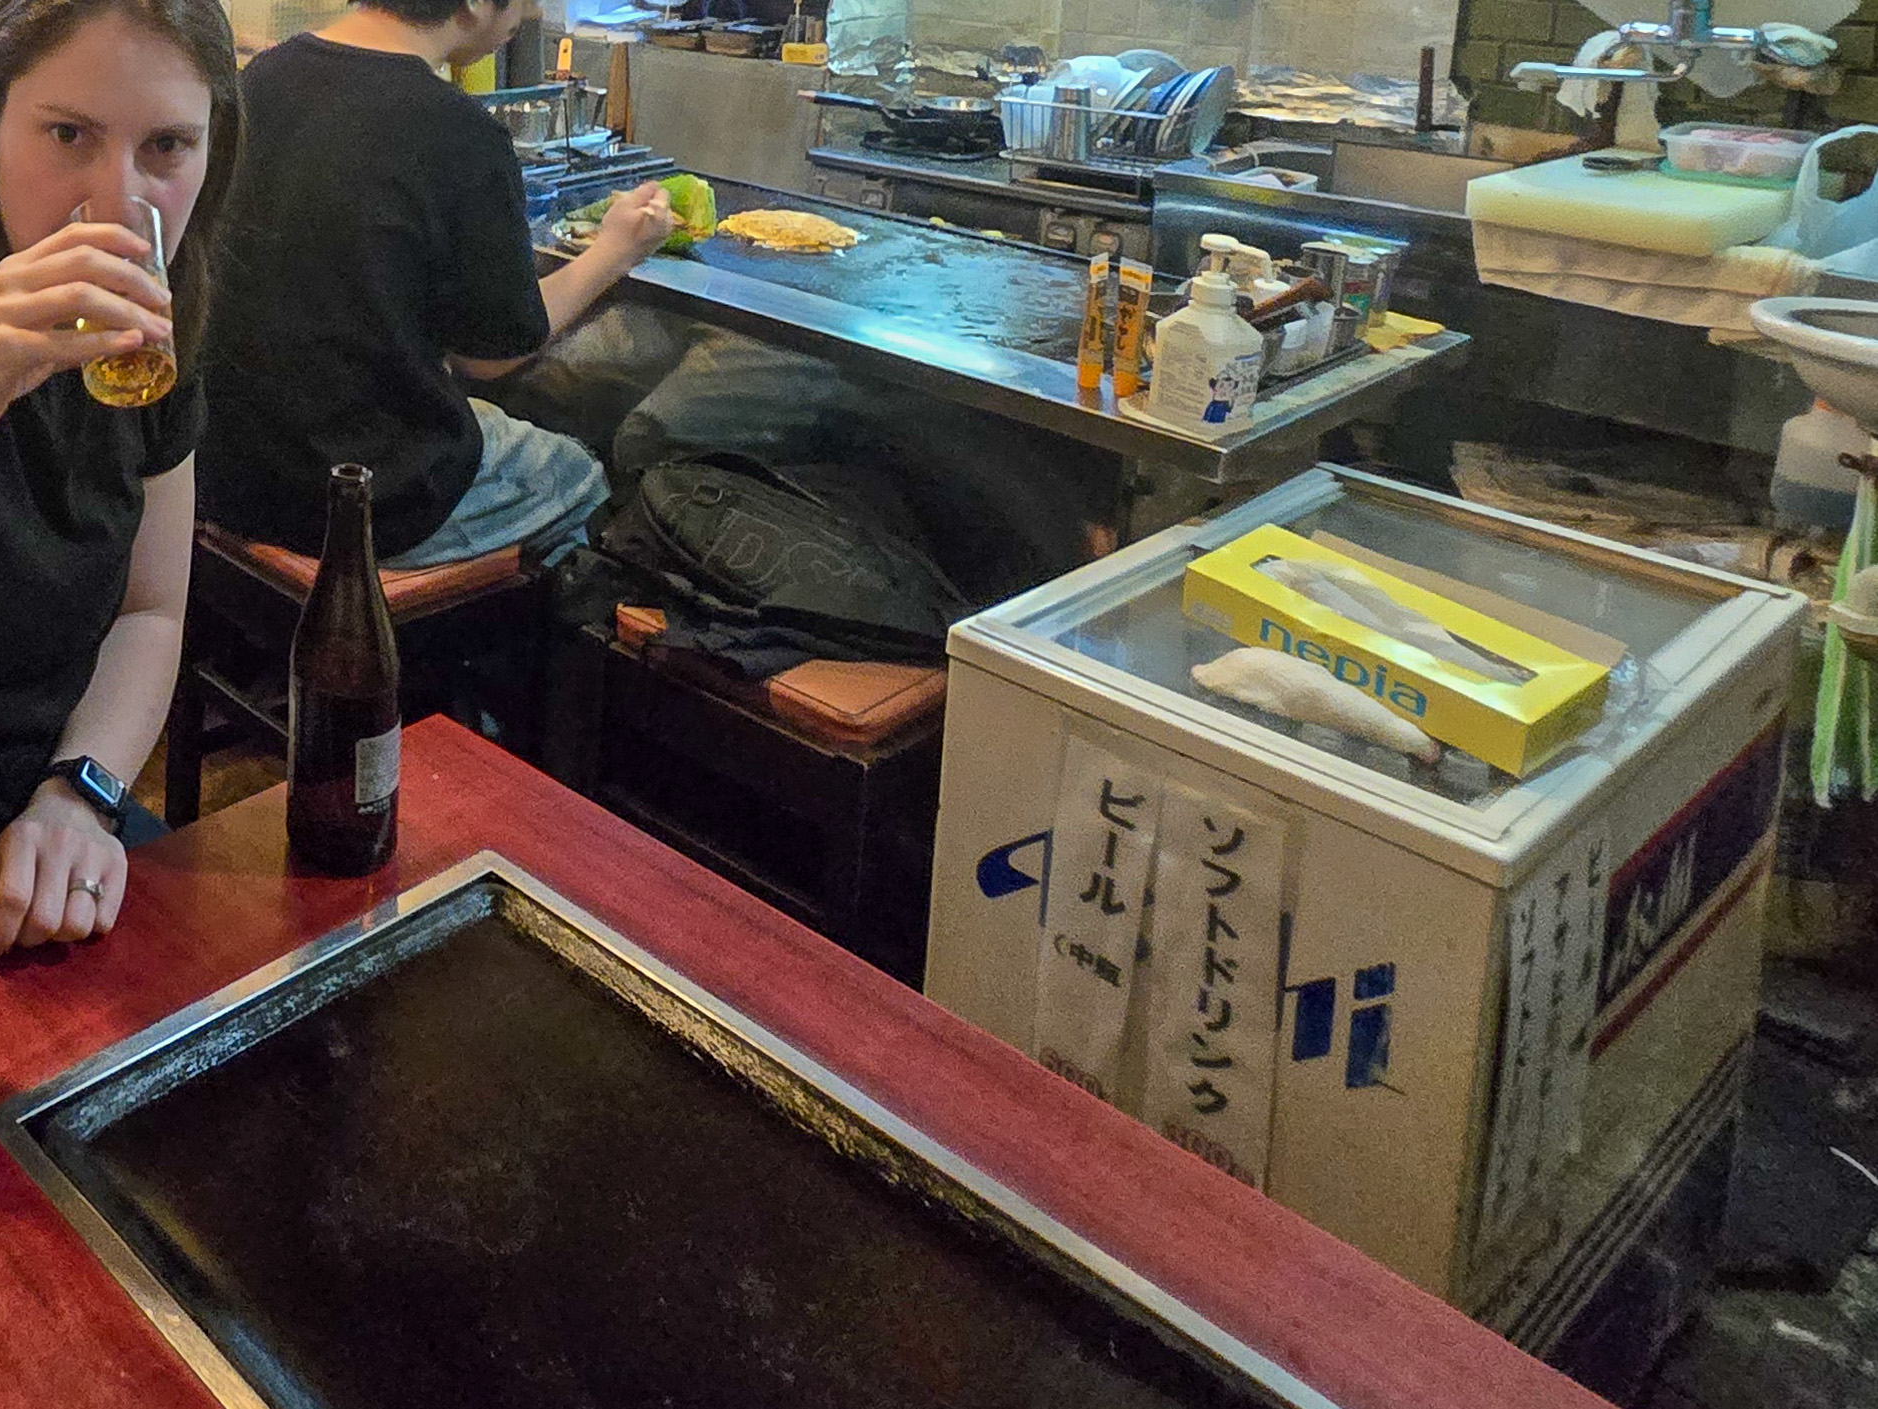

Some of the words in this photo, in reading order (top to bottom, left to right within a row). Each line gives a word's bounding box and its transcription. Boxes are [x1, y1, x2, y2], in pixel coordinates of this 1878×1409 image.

[1258, 617, 1428, 719] nepia
[1189, 816, 1246, 1115] ソフトドリンク
